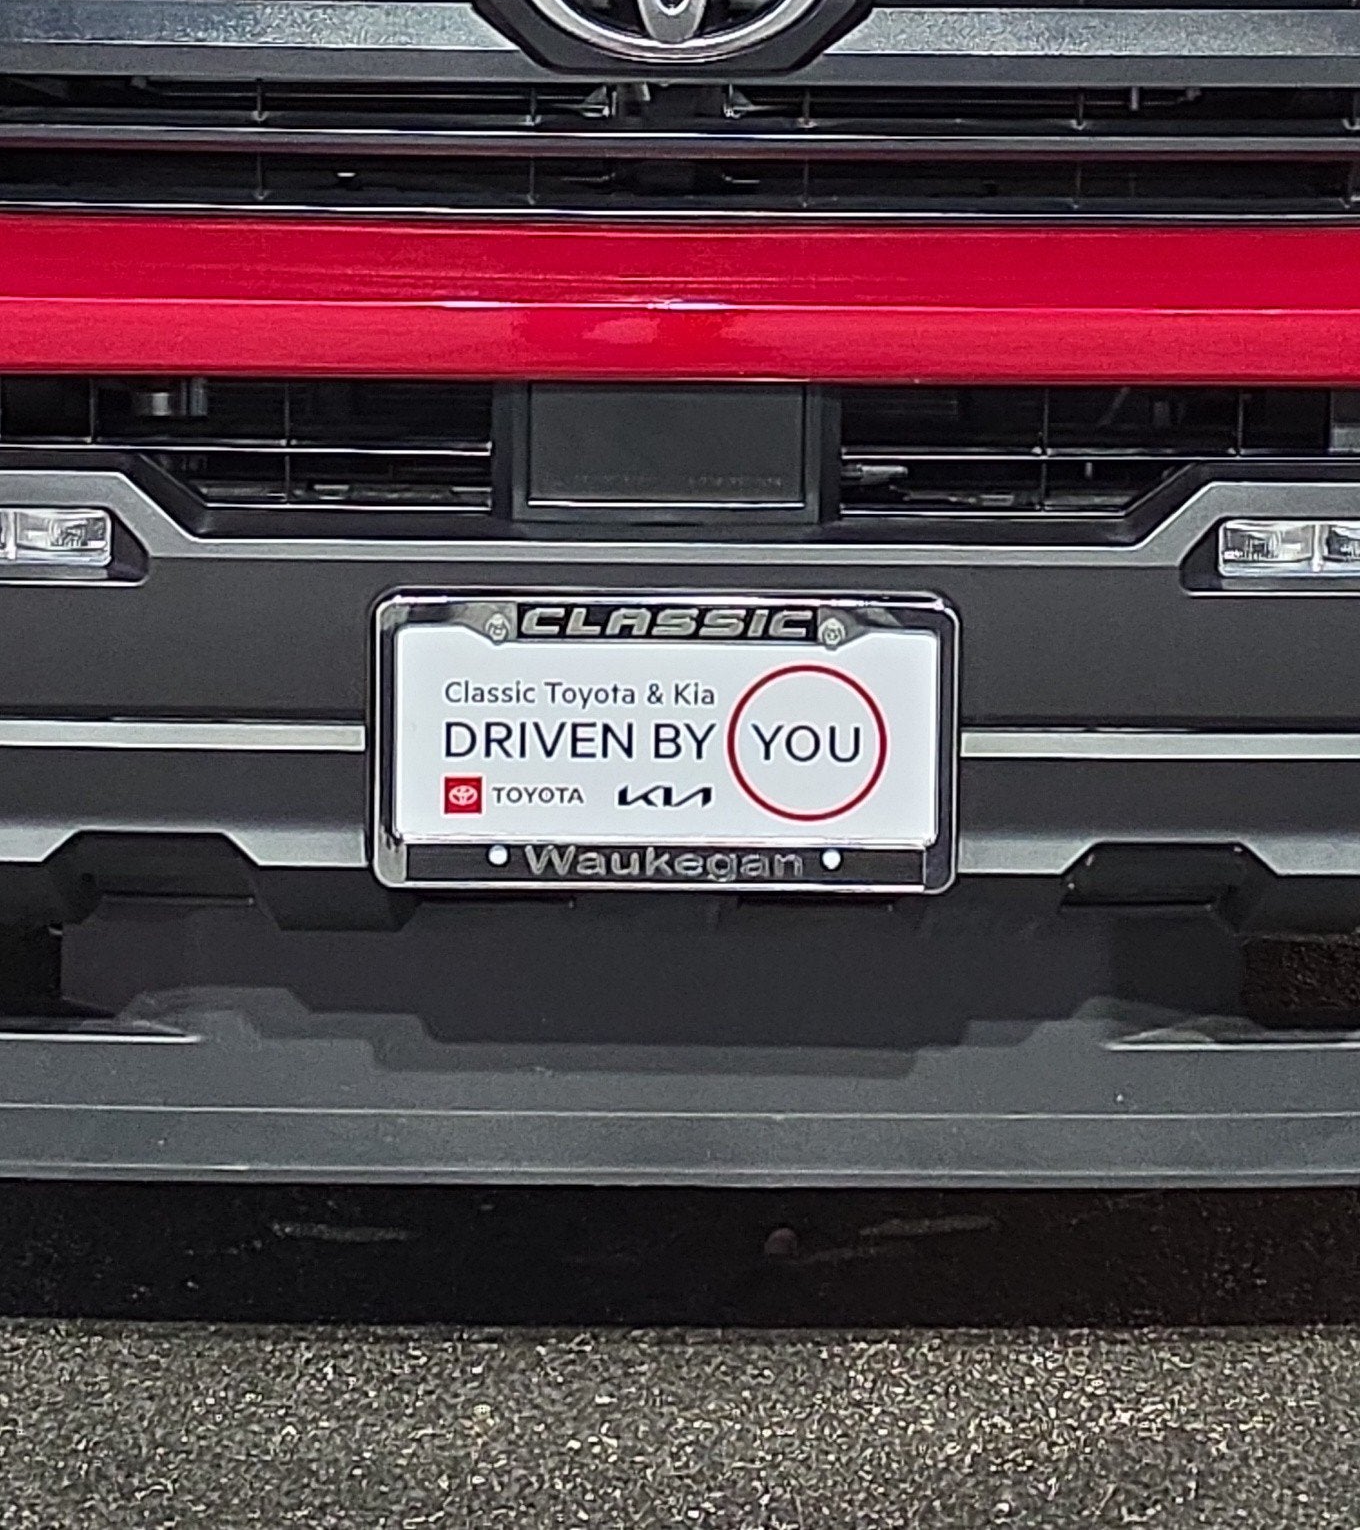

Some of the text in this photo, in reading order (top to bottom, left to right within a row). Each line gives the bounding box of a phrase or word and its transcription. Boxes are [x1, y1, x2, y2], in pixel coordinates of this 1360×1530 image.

[520, 608, 813, 637] CLASSIC
[444, 681, 715, 707] Classic Toyota & Kia
[444, 723, 862, 762] DRIVEN BY YOU
[492, 786, 584, 805] TOYOTA
[525, 845, 803, 882] Waukegan
